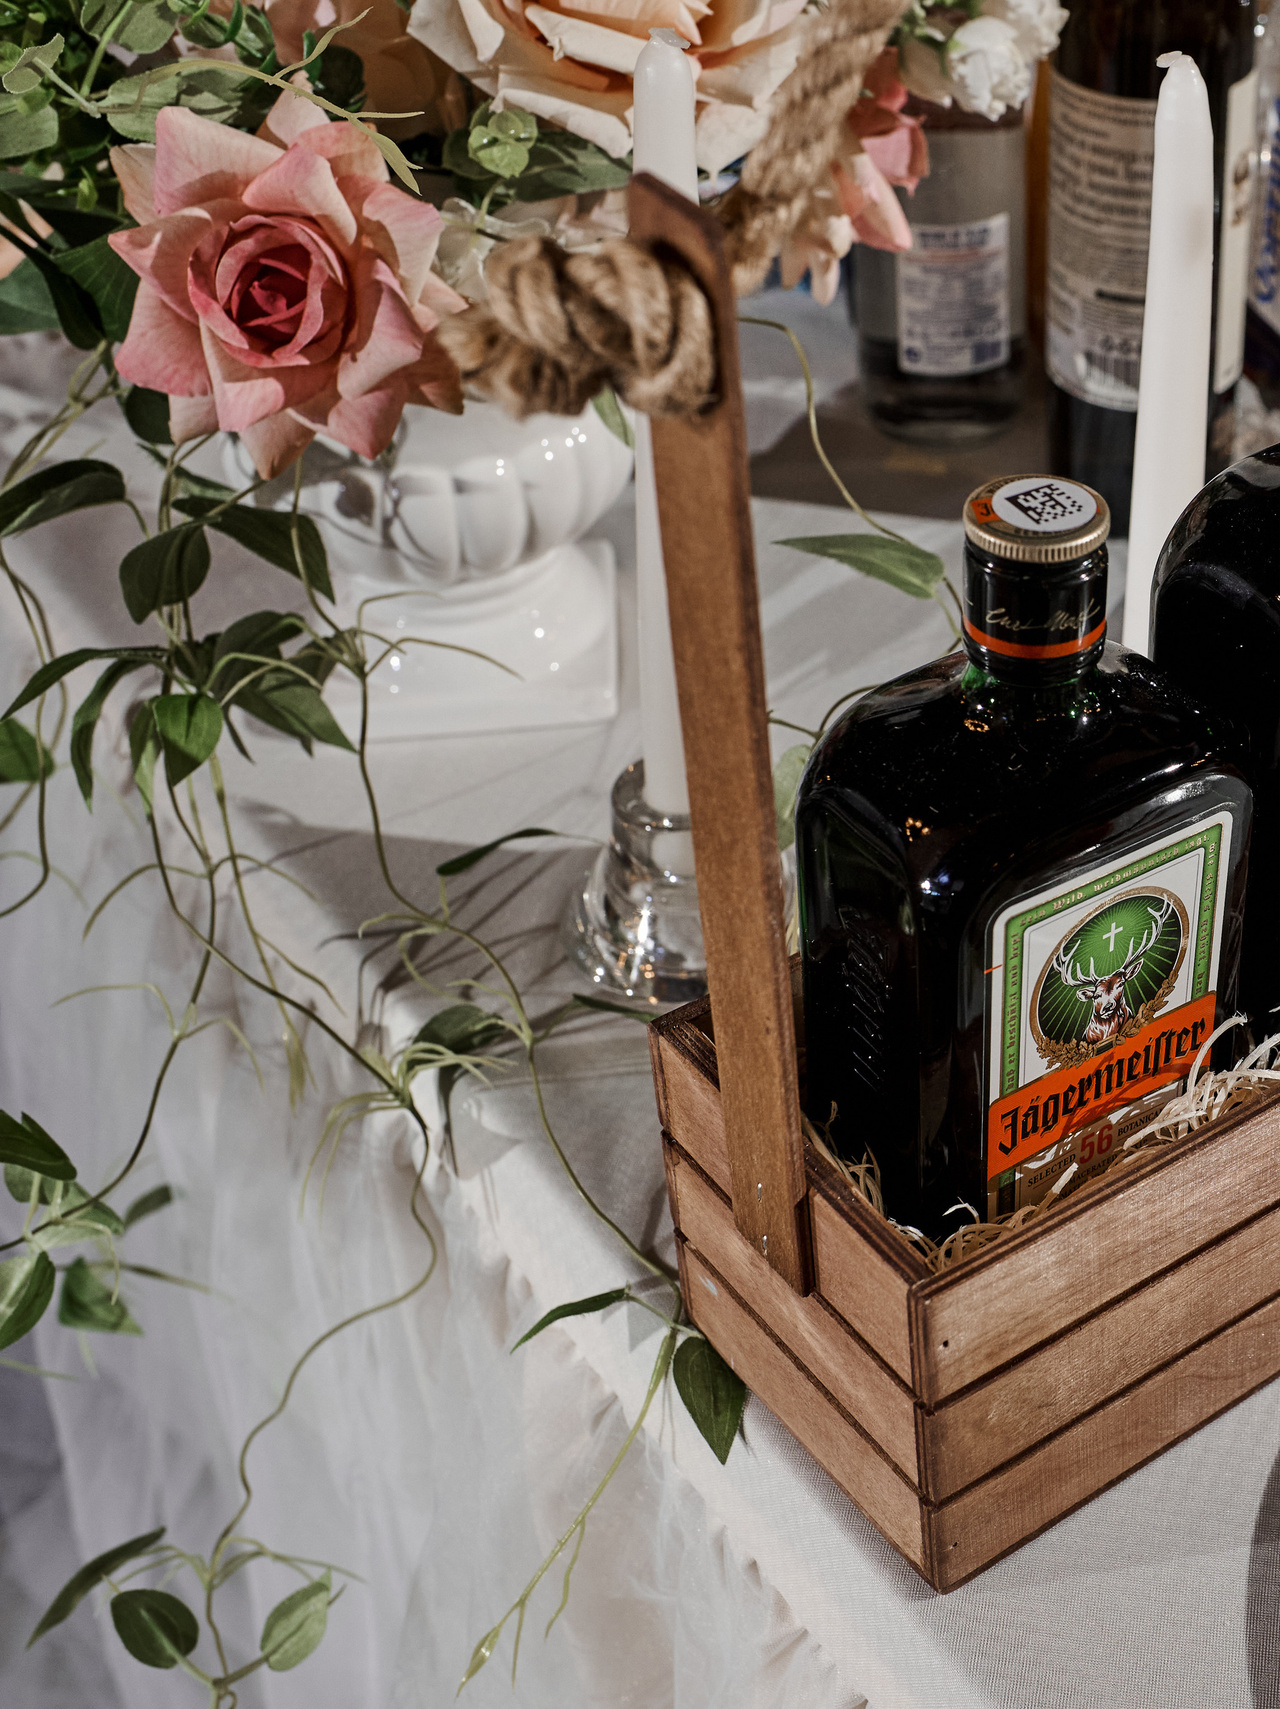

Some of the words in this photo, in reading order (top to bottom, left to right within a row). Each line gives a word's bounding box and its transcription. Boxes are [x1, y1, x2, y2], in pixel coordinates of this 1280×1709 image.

[1027, 1152, 1077, 1188] SELECTED
[1079, 1123, 1114, 1165] 56
[1116, 1108, 1163, 1137] BOTANICA
